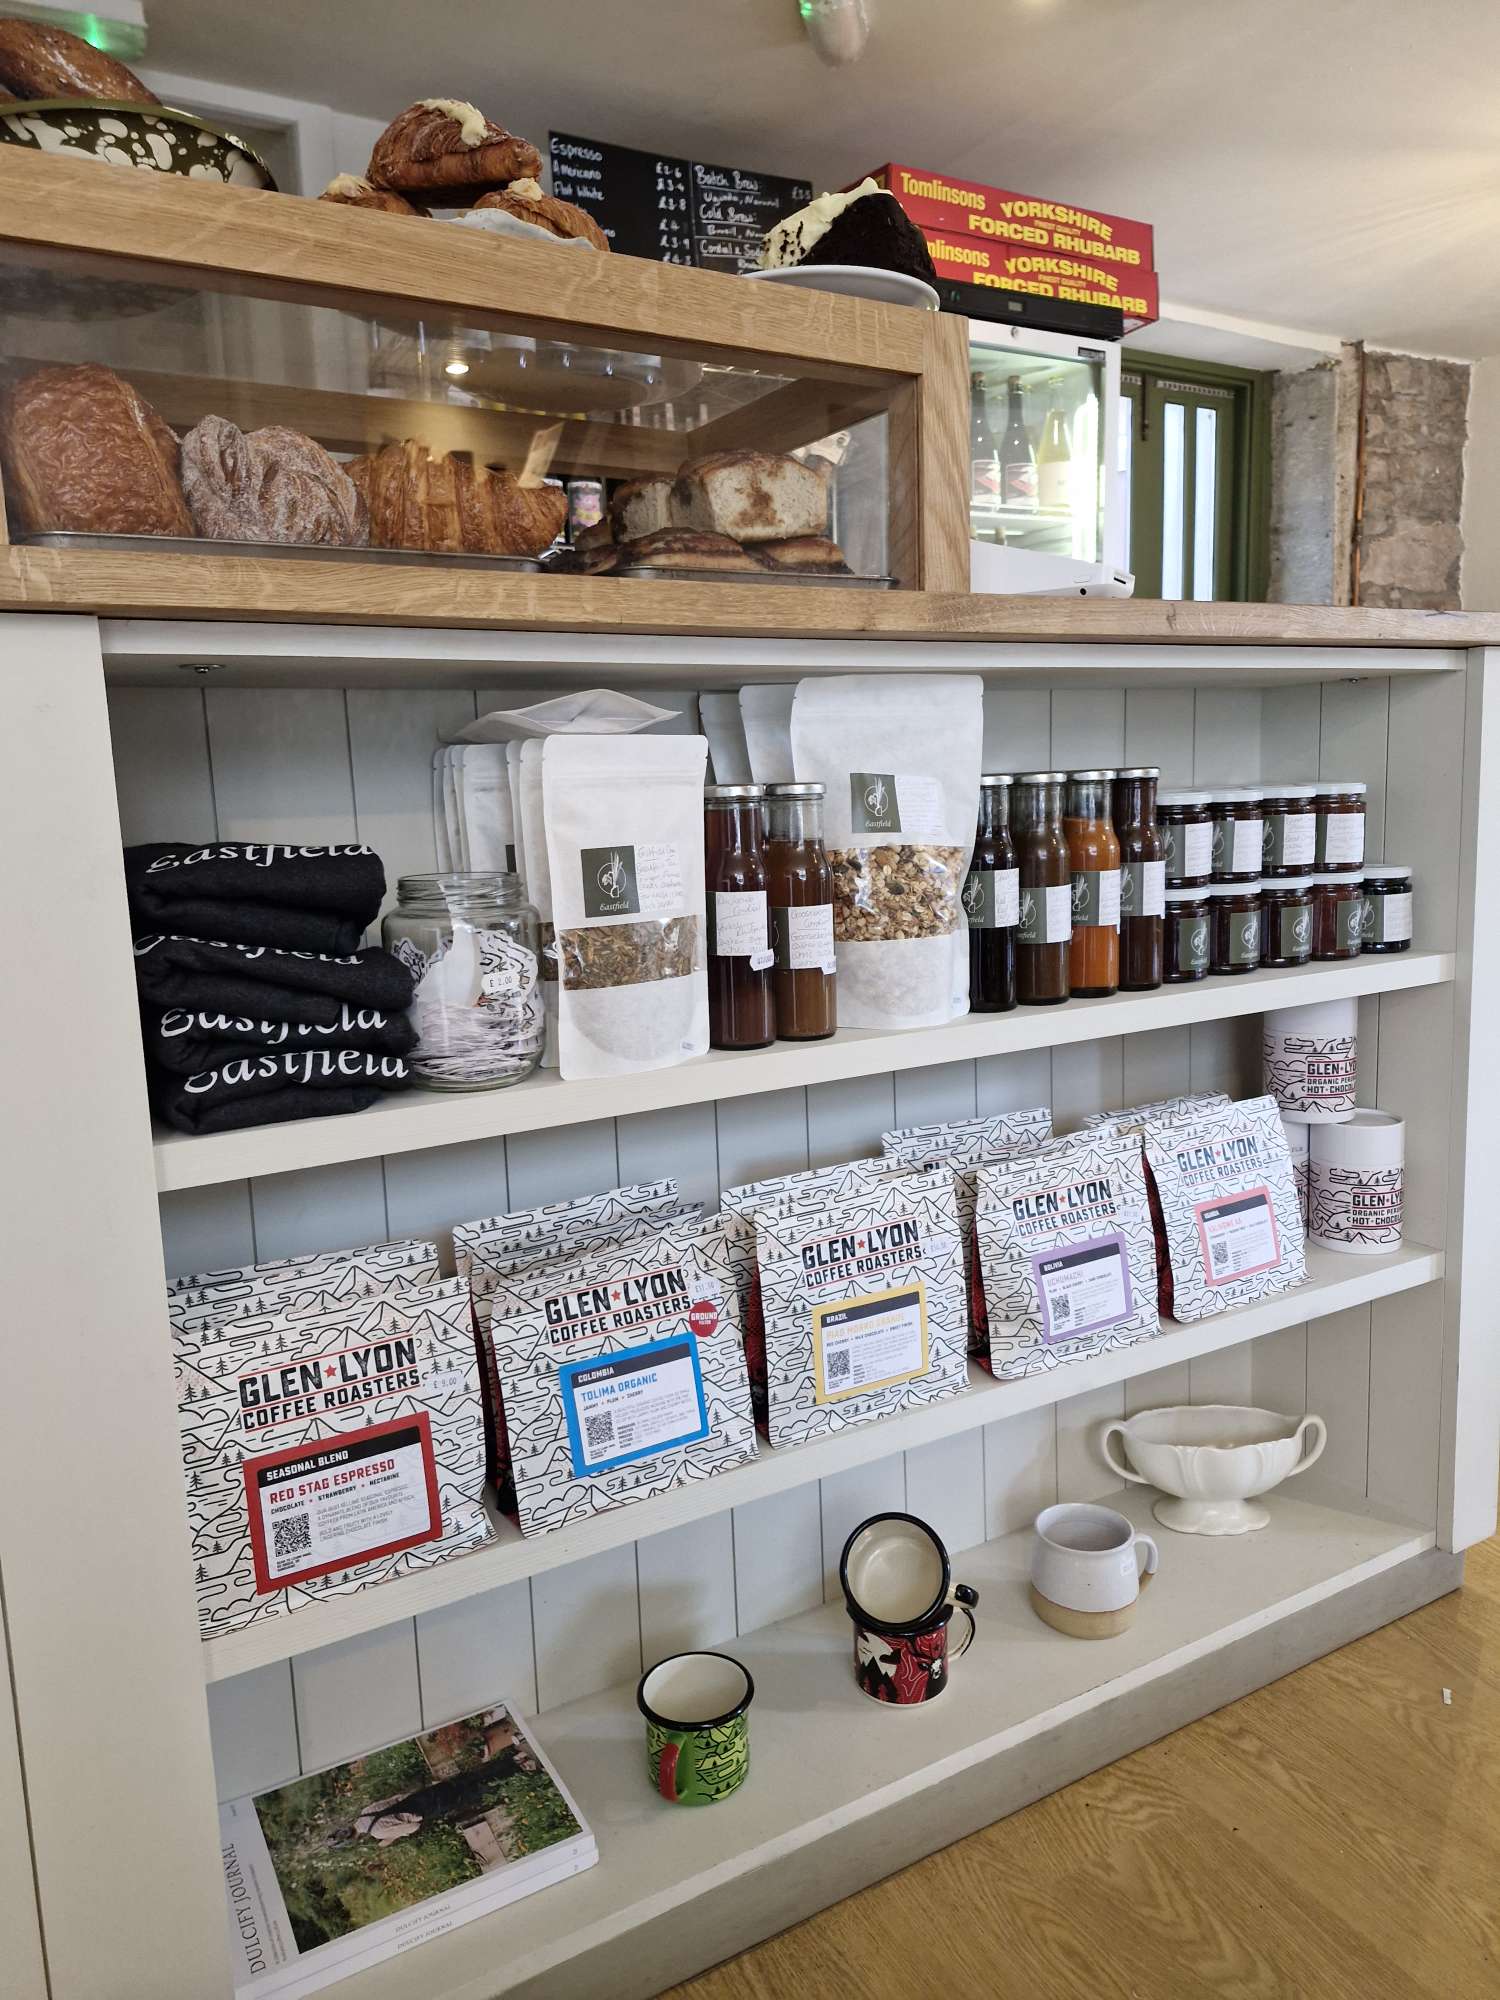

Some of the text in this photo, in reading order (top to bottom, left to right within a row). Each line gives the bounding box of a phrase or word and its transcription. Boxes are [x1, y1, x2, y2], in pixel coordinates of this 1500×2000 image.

[551, 138, 603, 161] Espresso
[694, 165, 729, 187] Batch
[900, 172, 986, 211] Tomlinsons
[576, 185, 605, 201] White
[699, 204, 723, 220] Cold
[1000, 200, 1113, 241] YORKSHIRE
[927, 239, 991, 268] mlinsons
[968, 214, 1140, 265] FORCED RHUBARB
[1004, 257, 1119, 292] YORKSHIRE
[1058, 286, 1148, 314] RHUBARB
[599, 901, 630, 912] Eastfield
[1307, 1063, 1340, 1075] GLEN
[1307, 1086, 1325, 1094] HOT
[1177, 1135, 1259, 1173] GLEN LYON
[1183, 1156, 1263, 1187] COFFEE ROASTERS
[1012, 1178, 1112, 1221] GLEN LYON
[1352, 1194, 1386, 1207] GLEN
[1352, 1209, 1386, 1217] ORGANIC
[1018, 1216, 1058, 1237] COFFEE
[1061, 1202, 1117, 1225] ROASTERS
[1352, 1217, 1370, 1225] HOT
[802, 1219, 919, 1270] GLEN LYON
[806, 1263, 852, 1288] COFFEE
[857, 1245, 922, 1274] ROASTERS
[545, 1268, 687, 1325] GLEN LYON
[550, 1295, 691, 1344] COFFEE ROASTERS
[690, 1311, 718, 1321] GROUND
[238, 1338, 416, 1409] GLEN LYON
[578, 1366, 615, 1383] COLOMBIA
[581, 1373, 658, 1402] TOLIMA ORGANIC
[243, 1368, 420, 1430] COFFEE ROASTERS
[266, 1450, 349, 1482] SEASONAL BLEND
[270, 1487, 295, 1505] RED
[298, 1478, 330, 1497] STAG
[333, 1458, 396, 1486] ESPRESSO
[271, 1500, 305, 1516] CHOCOLATE
[318, 1485, 357, 1501] STRAWBERRY
[369, 1472, 400, 1486] NECTARINE
[222, 1843, 252, 1904] JOURNAL
[235, 1905, 266, 1974] DULCIFY
